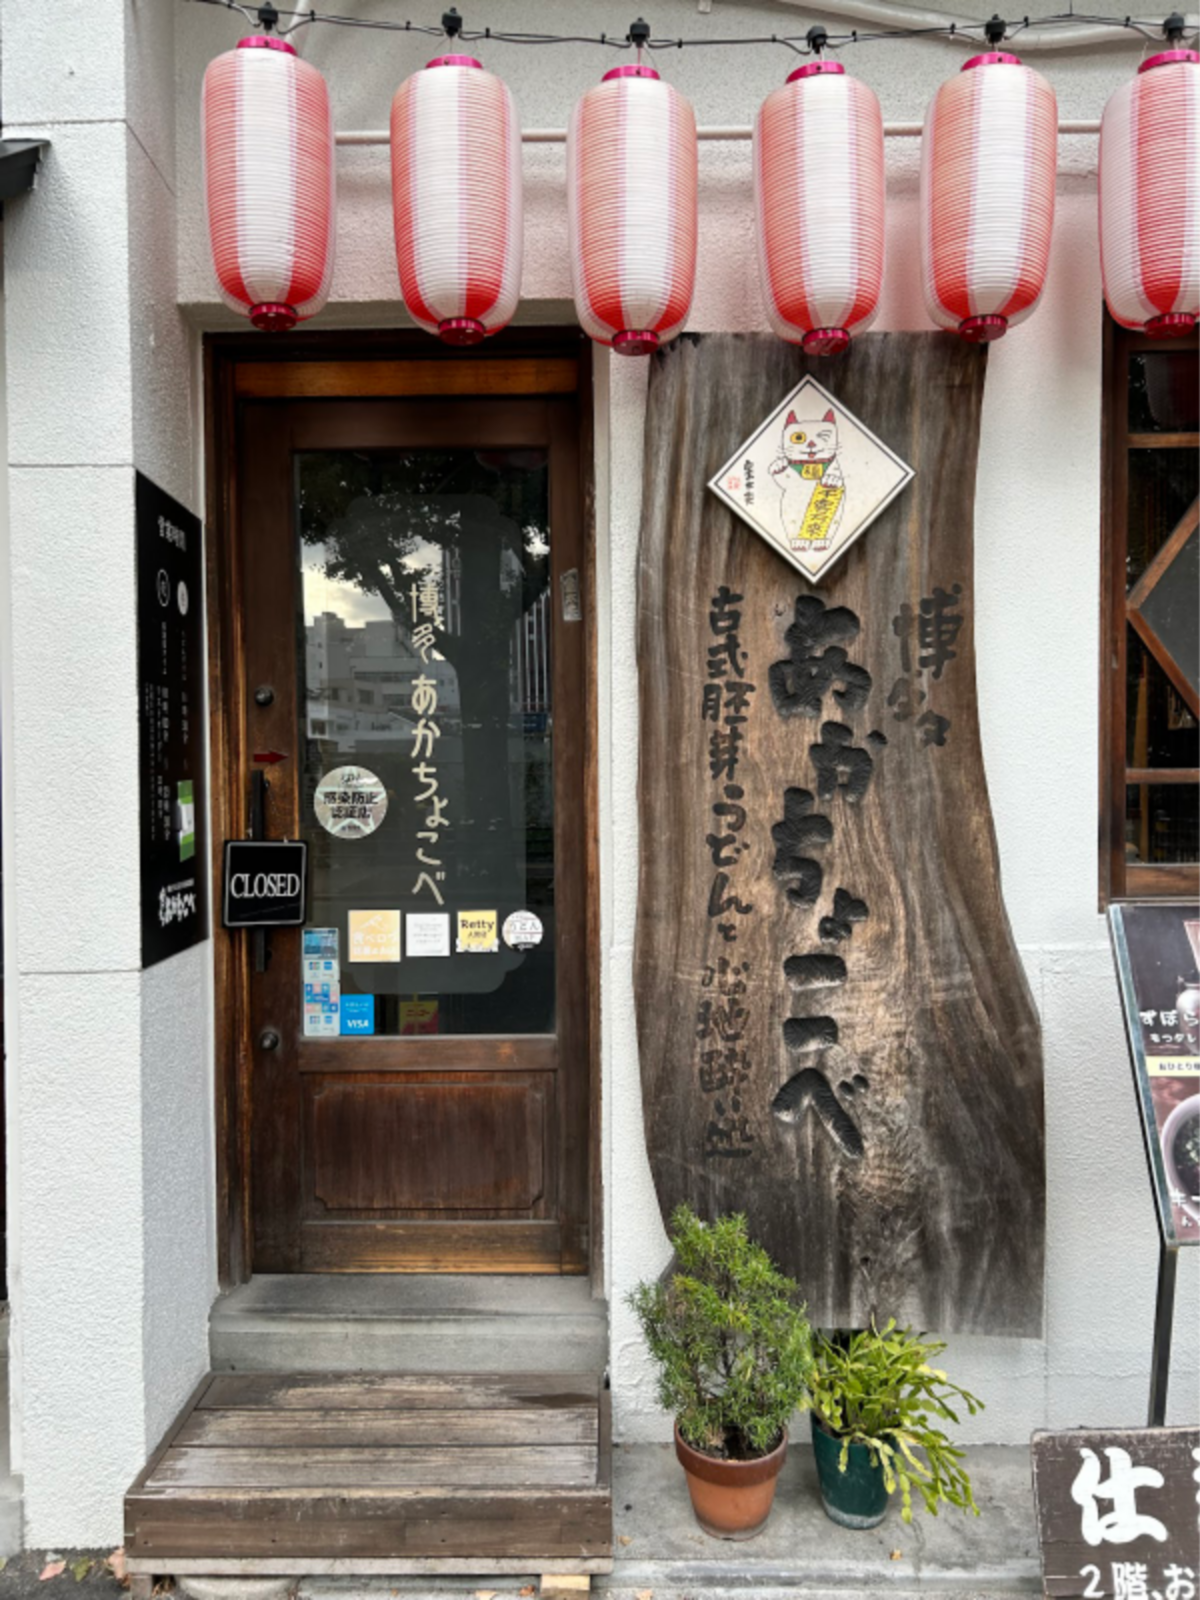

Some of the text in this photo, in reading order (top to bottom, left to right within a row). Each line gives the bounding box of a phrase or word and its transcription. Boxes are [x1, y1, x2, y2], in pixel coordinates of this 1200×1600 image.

[411, 674, 449, 905] あかちょこべ
[230, 873, 300, 898] CLOSED
[460, 919, 495, 933] Retty
[346, 1019, 369, 1029] VISA
